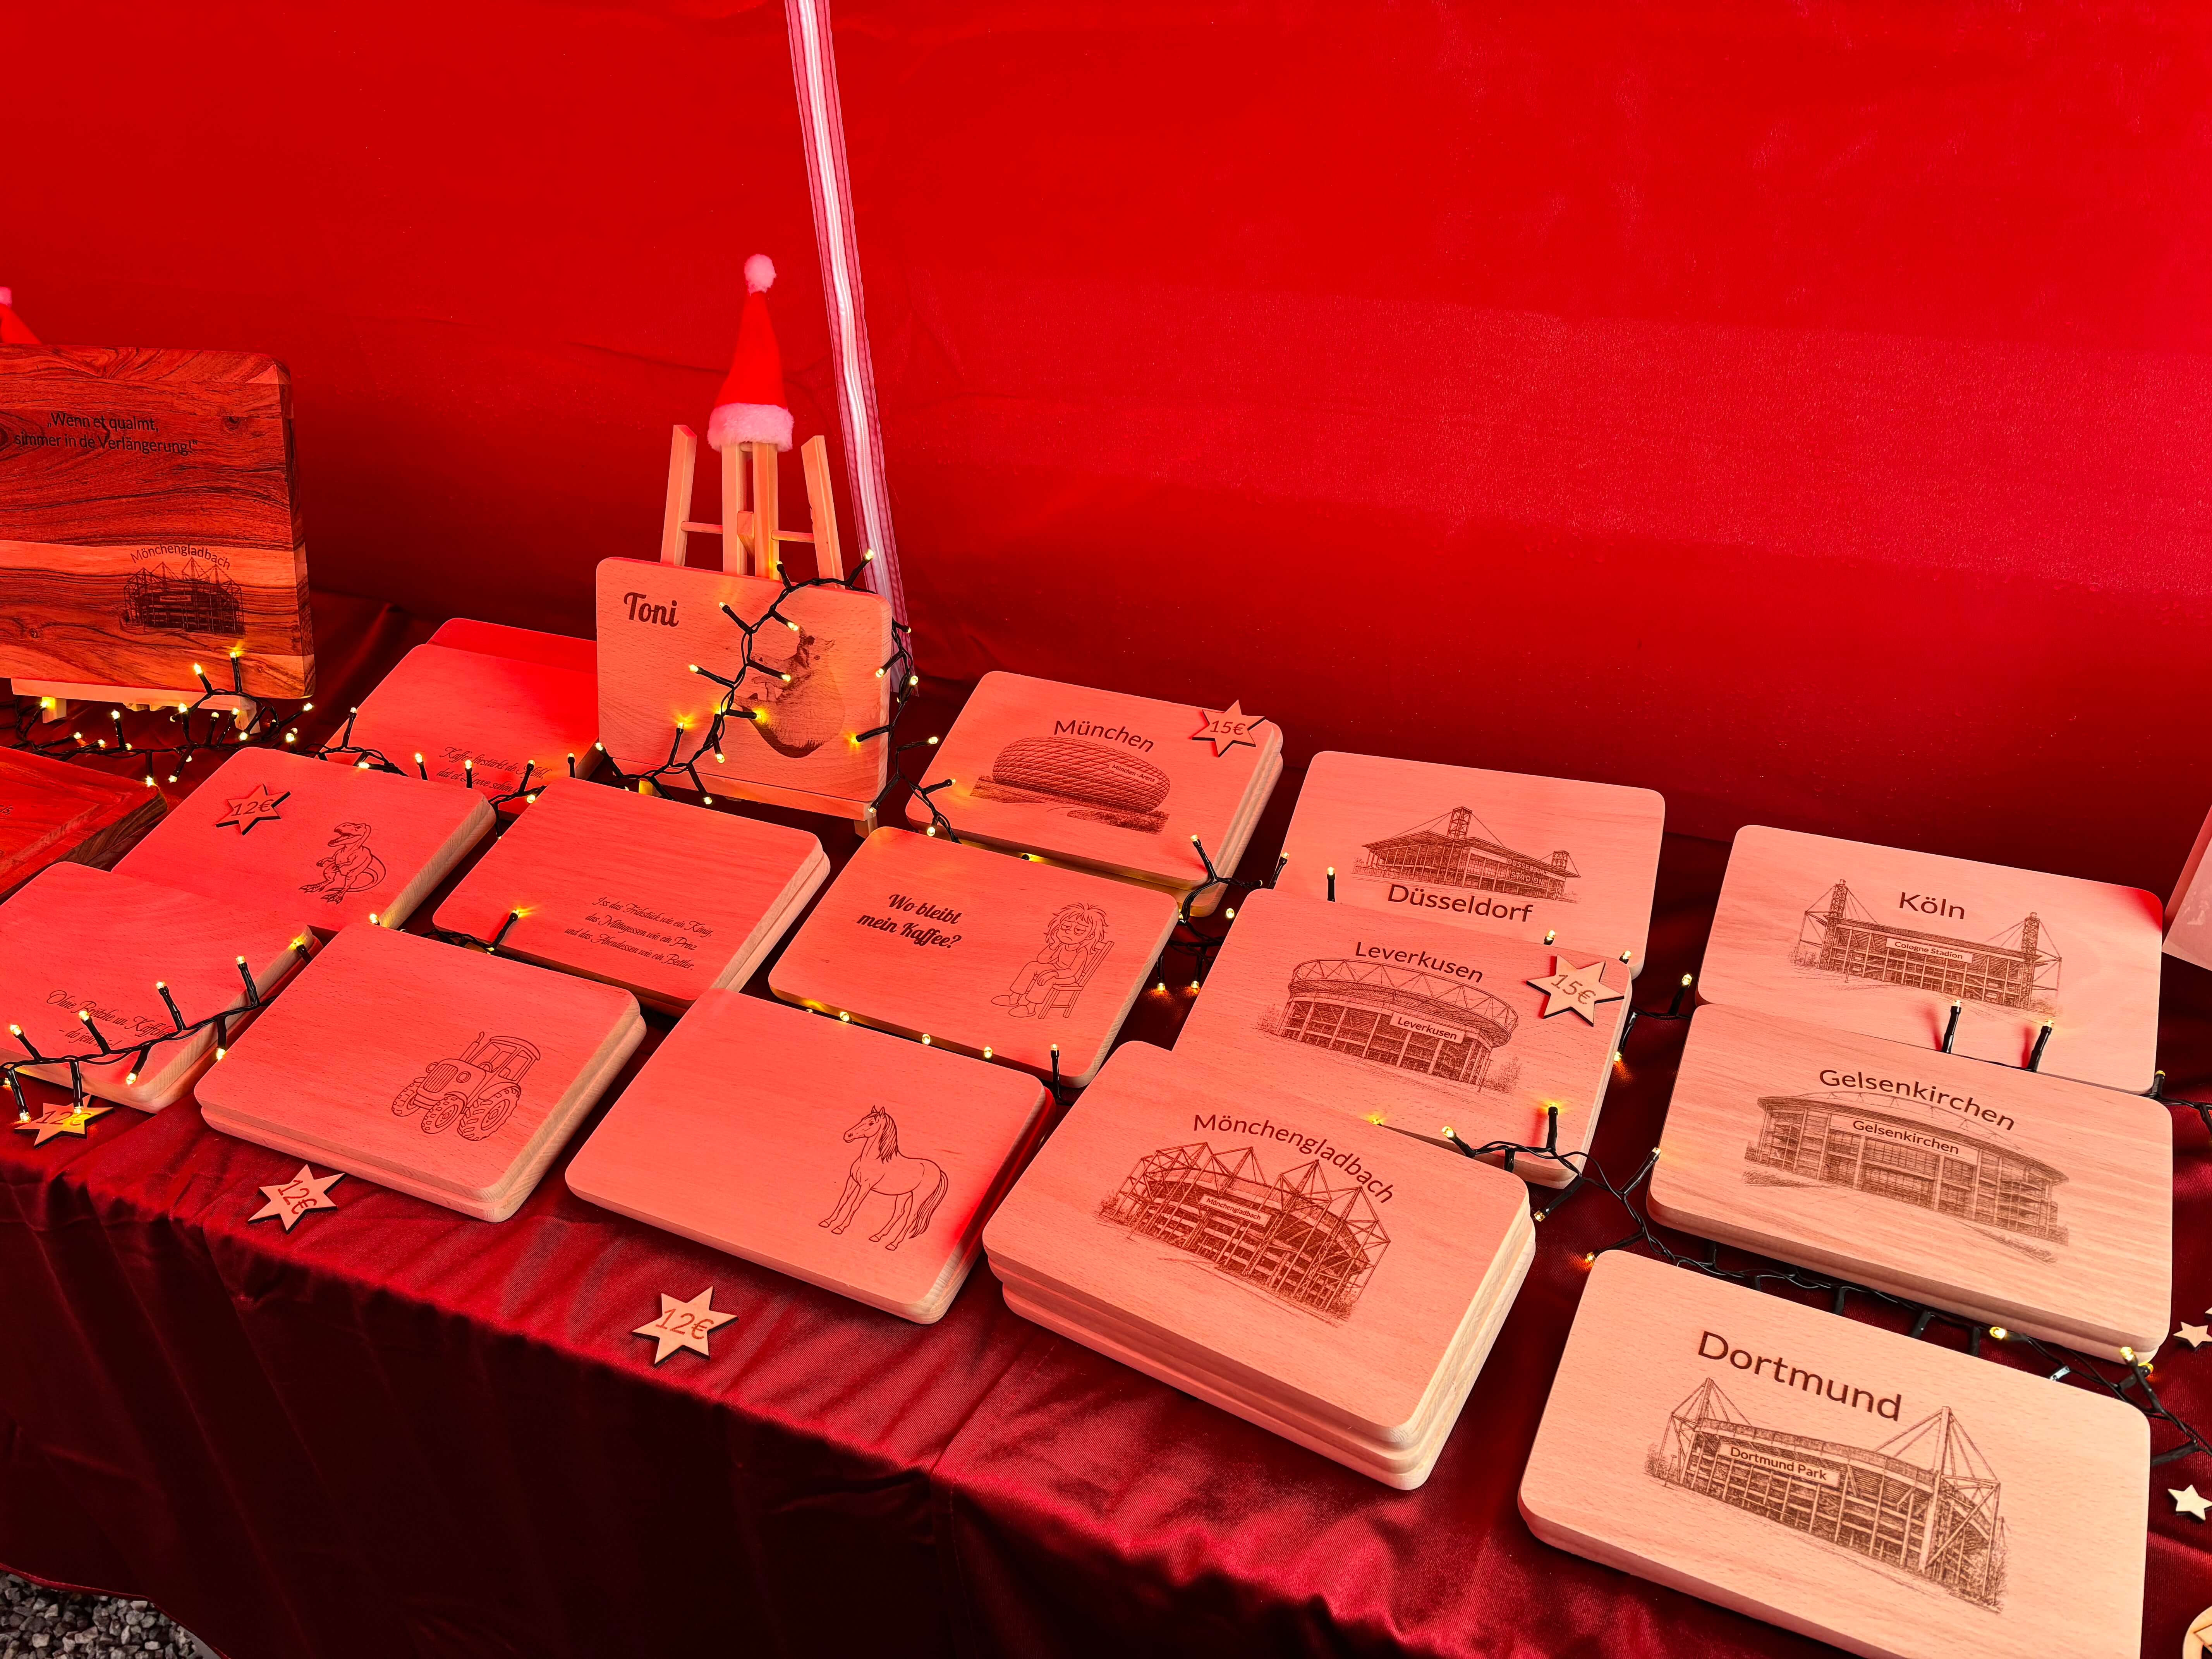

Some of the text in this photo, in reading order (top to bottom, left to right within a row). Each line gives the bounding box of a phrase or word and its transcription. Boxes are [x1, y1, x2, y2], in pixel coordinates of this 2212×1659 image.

[93, 415, 106, 424] et
[109, 416, 159, 433] qualmt,
[15, 431, 61, 446] simmer
[65, 434, 76, 447] in
[79, 434, 95, 448] de
[131, 543, 230, 570] Mönchengladbach
[623, 592, 679, 627] Toni
[1054, 720, 1154, 752] München
[1210, 720, 1246, 735] 15€
[1112, 764, 1136, 776] München
[1139, 774, 1155, 782] Arena
[231, 799, 274, 816] 12€
[609, 902, 623, 910] das
[622, 903, 665, 922] Frühstück
[659, 916, 674, 925] wie
[673, 920, 685, 928] ein
[889, 894, 962, 924] Wo bleibt
[1388, 884, 1534, 922] Düsseldorf
[1899, 892, 1965, 919] Köln
[564, 928, 584, 936] und
[578, 930, 593, 940] das
[590, 933, 639, 953] Abendessen
[651, 953, 664, 961] ein
[585, 913, 697, 951] das Mittagessen wie ein Prinz
[856, 915, 962, 948] mein Kaffee?
[1355, 941, 1483, 983] Leverkusen
[1894, 941, 1963, 959] Cologne Stadion
[46, 990, 77, 1009] Ohne
[1551, 974, 1596, 1004] 15€
[1398, 1017, 1457, 1040] Leverkusen
[1820, 1069, 2014, 1131] Gelsenkirchen
[36, 1110, 91, 1126] 12€
[1853, 1120, 1959, 1154] Gelsenkirchen
[1194, 1114, 1394, 1204] Mönchengladbach
[277, 1180, 317, 1214] 12€
[1206, 1197, 1261, 1220] Mönchengladbach
[655, 1308, 714, 1340] 12€
[1698, 1330, 1902, 1422] Dortmund
[1730, 1447, 1827, 1481] Dortmund Park
